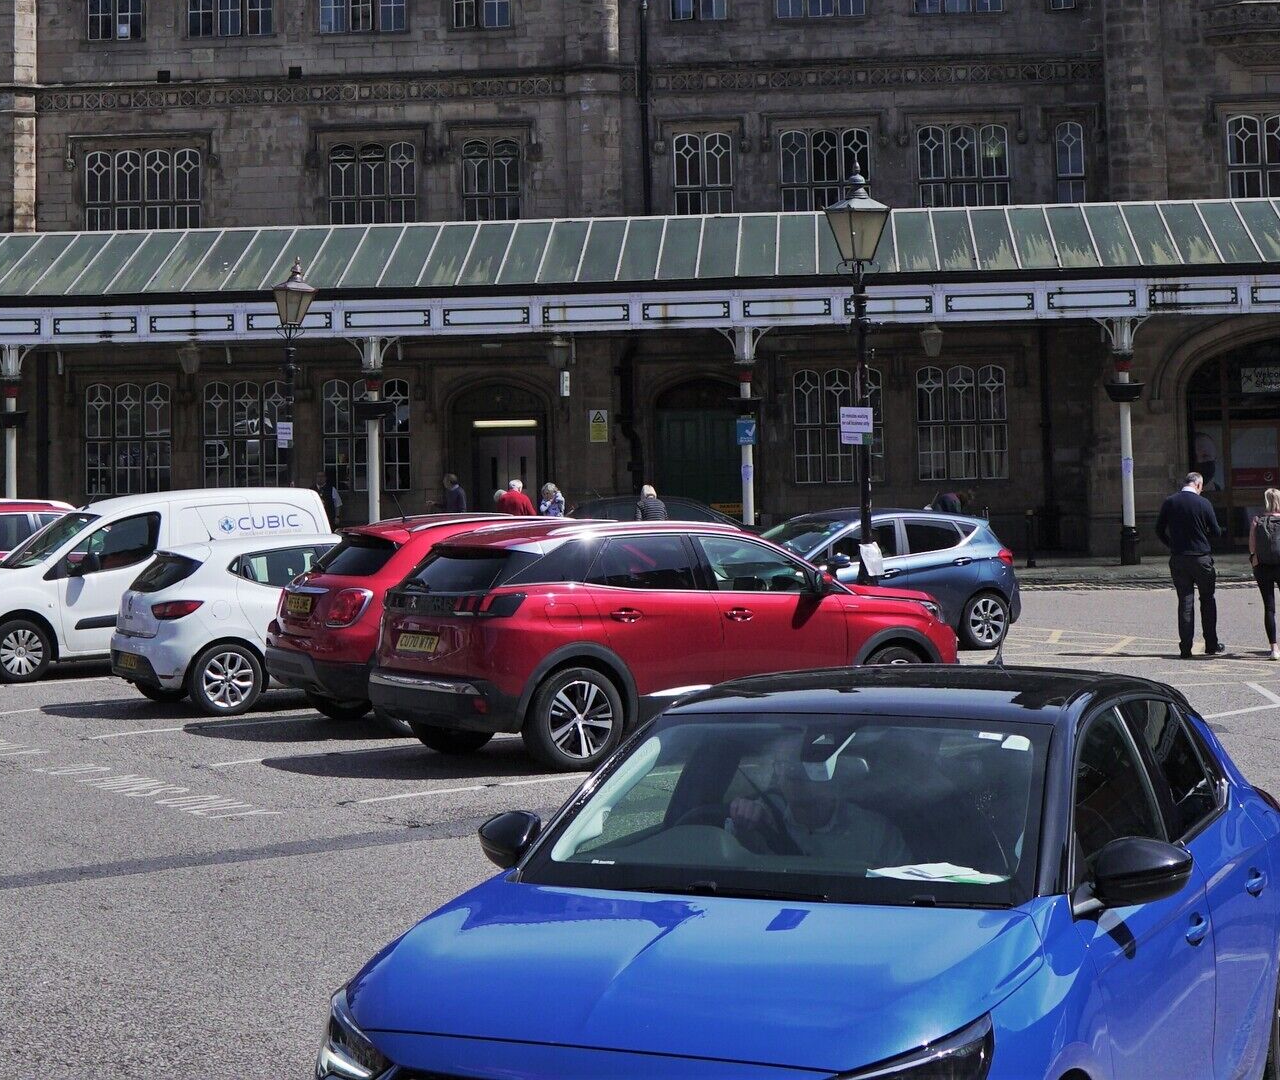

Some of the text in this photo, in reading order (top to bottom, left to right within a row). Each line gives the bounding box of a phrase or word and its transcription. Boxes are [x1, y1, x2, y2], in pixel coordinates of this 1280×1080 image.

[238, 514, 299, 531] CUBIC
[75, 774, 191, 797] MINS
[154, 794, 283, 819] ONLY
